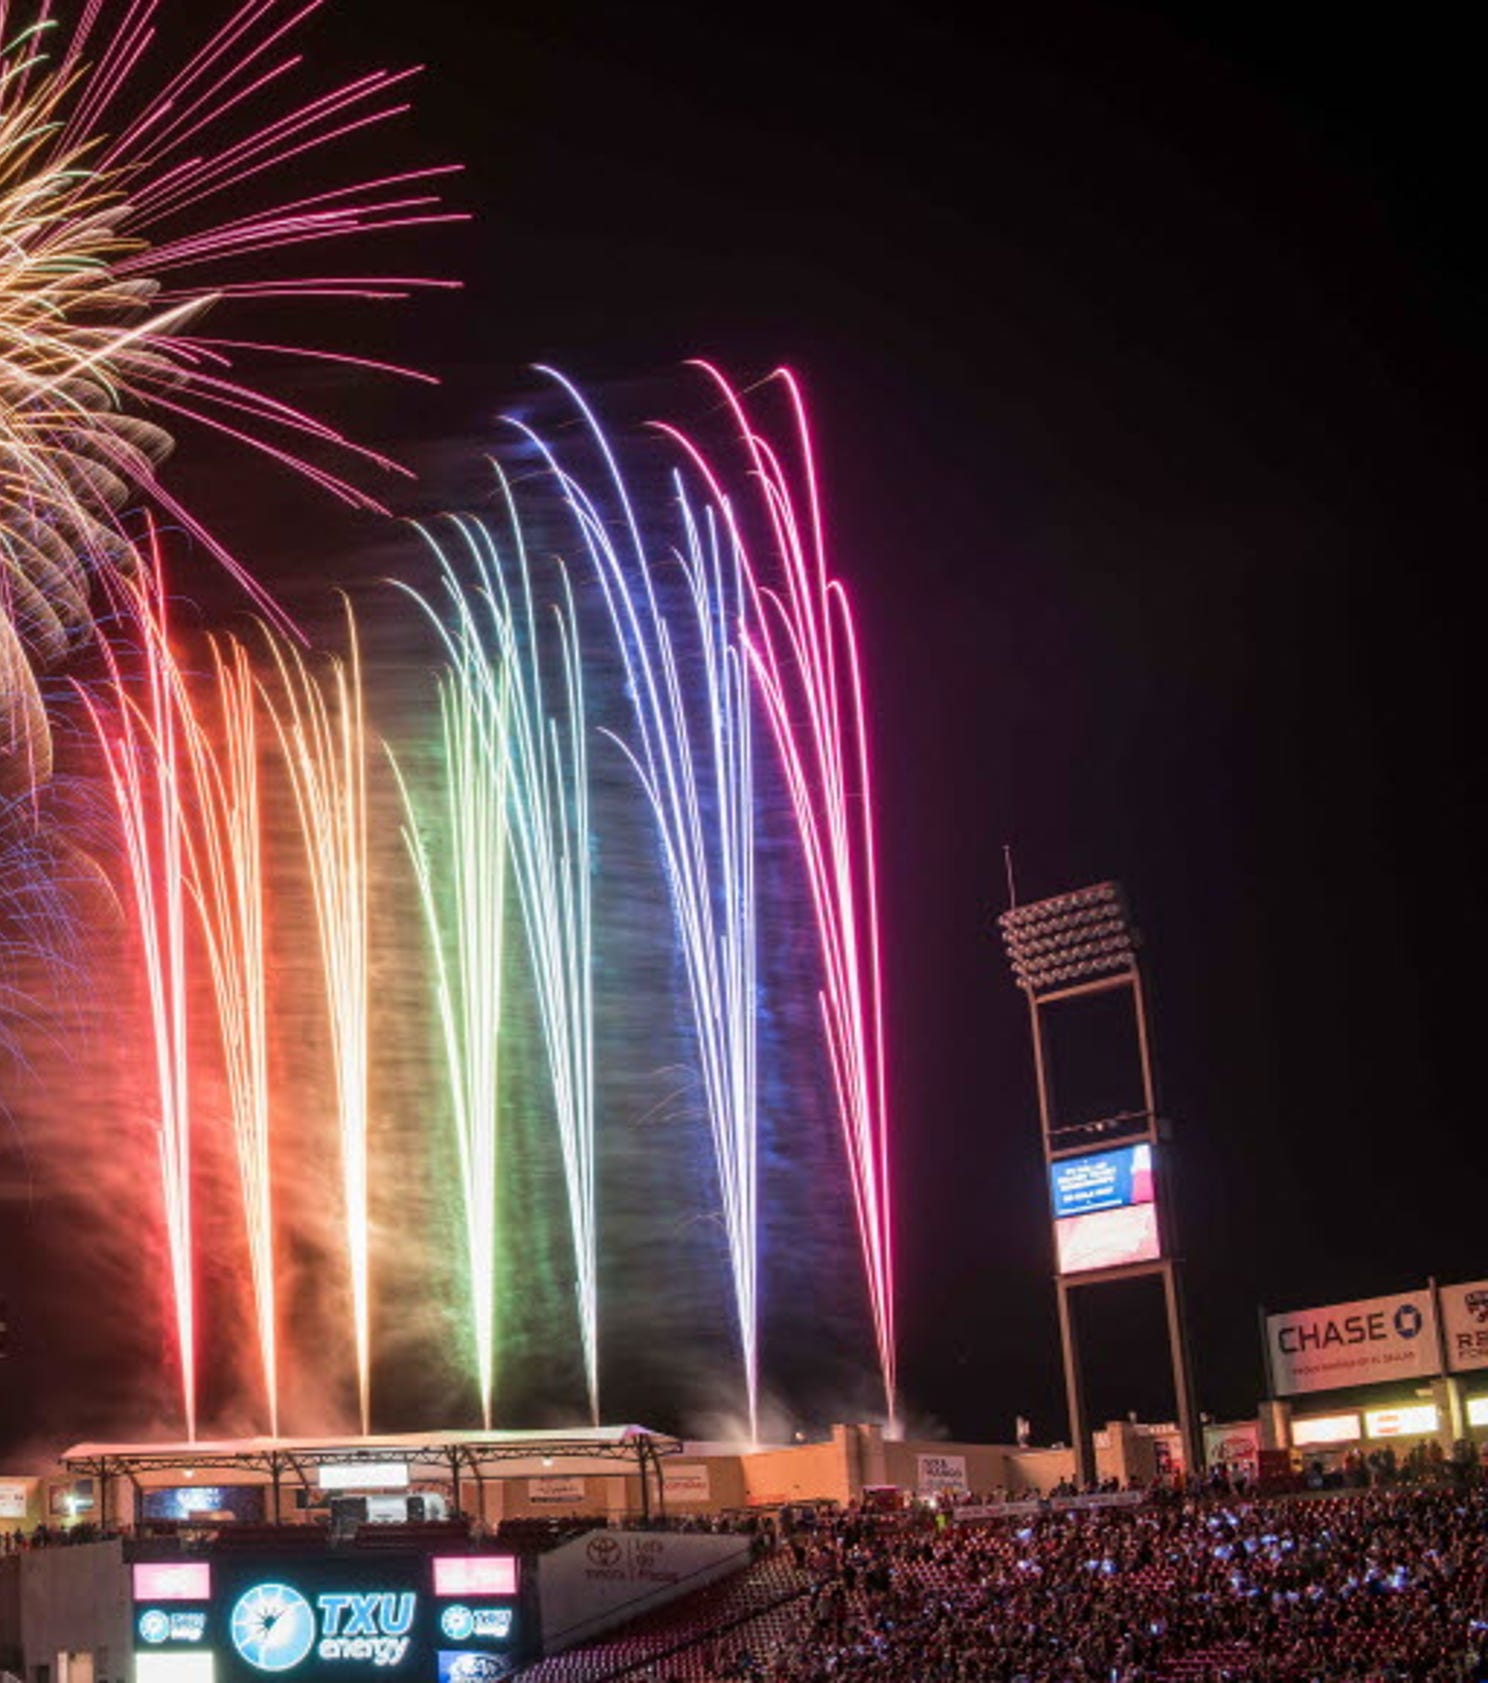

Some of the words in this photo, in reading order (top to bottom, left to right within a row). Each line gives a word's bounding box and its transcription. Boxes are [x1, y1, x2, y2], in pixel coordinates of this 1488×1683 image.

[1277, 1312, 1388, 1353] CHASE
[318, 1592, 416, 1636] TXU
[319, 1636, 410, 1667] energy
